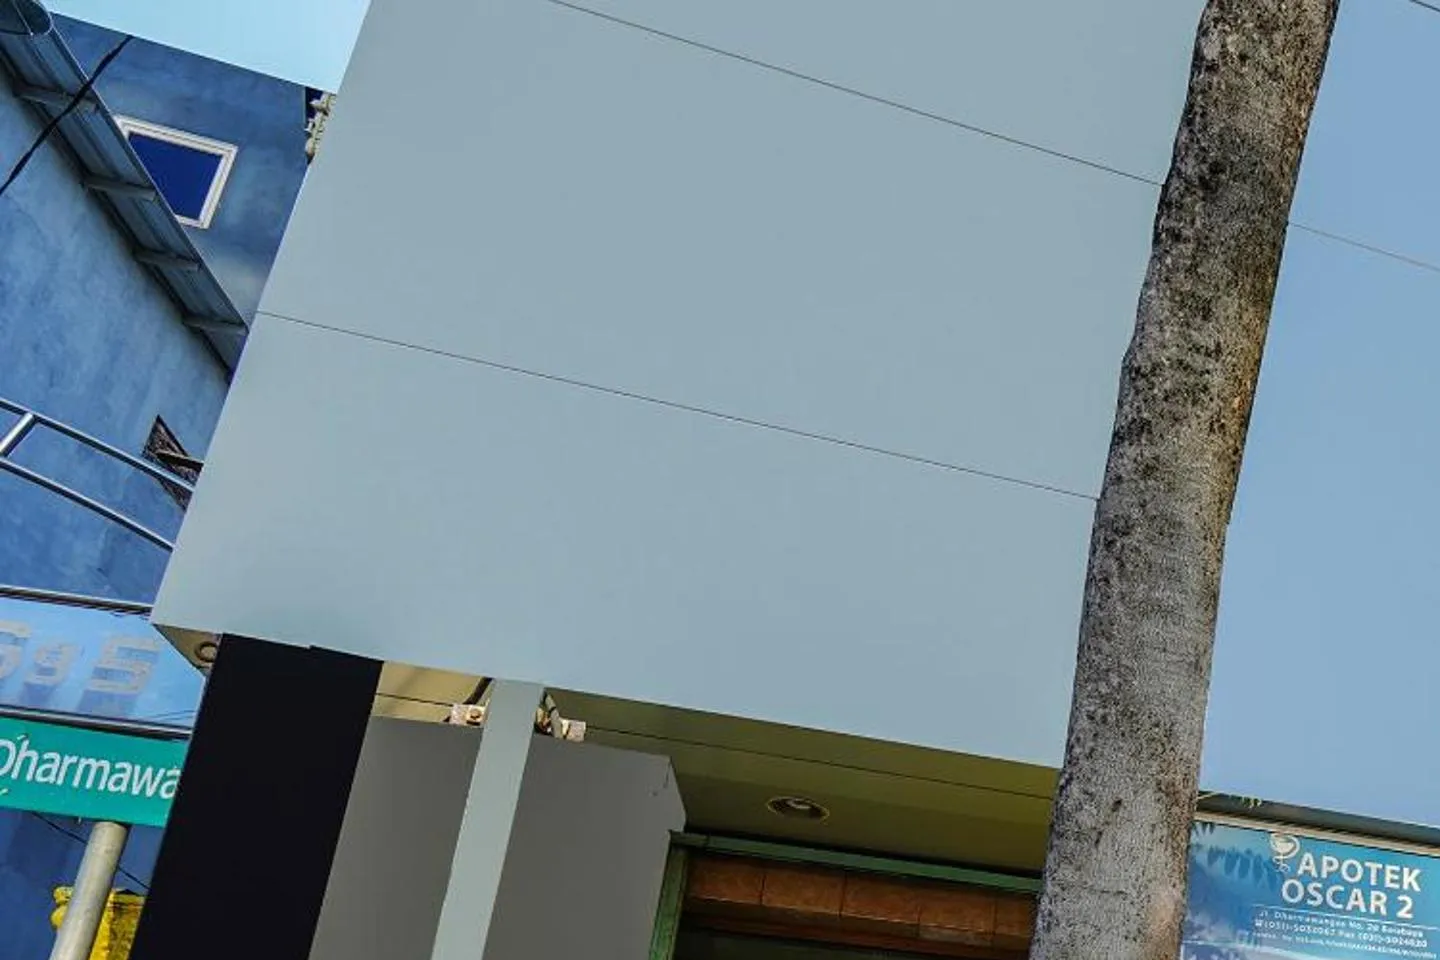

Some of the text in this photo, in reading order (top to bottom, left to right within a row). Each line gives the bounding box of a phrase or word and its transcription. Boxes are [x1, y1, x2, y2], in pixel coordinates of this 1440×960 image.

[1297, 852, 1422, 893] APOTEK
[1281, 880, 1414, 919] OSCAR 2
